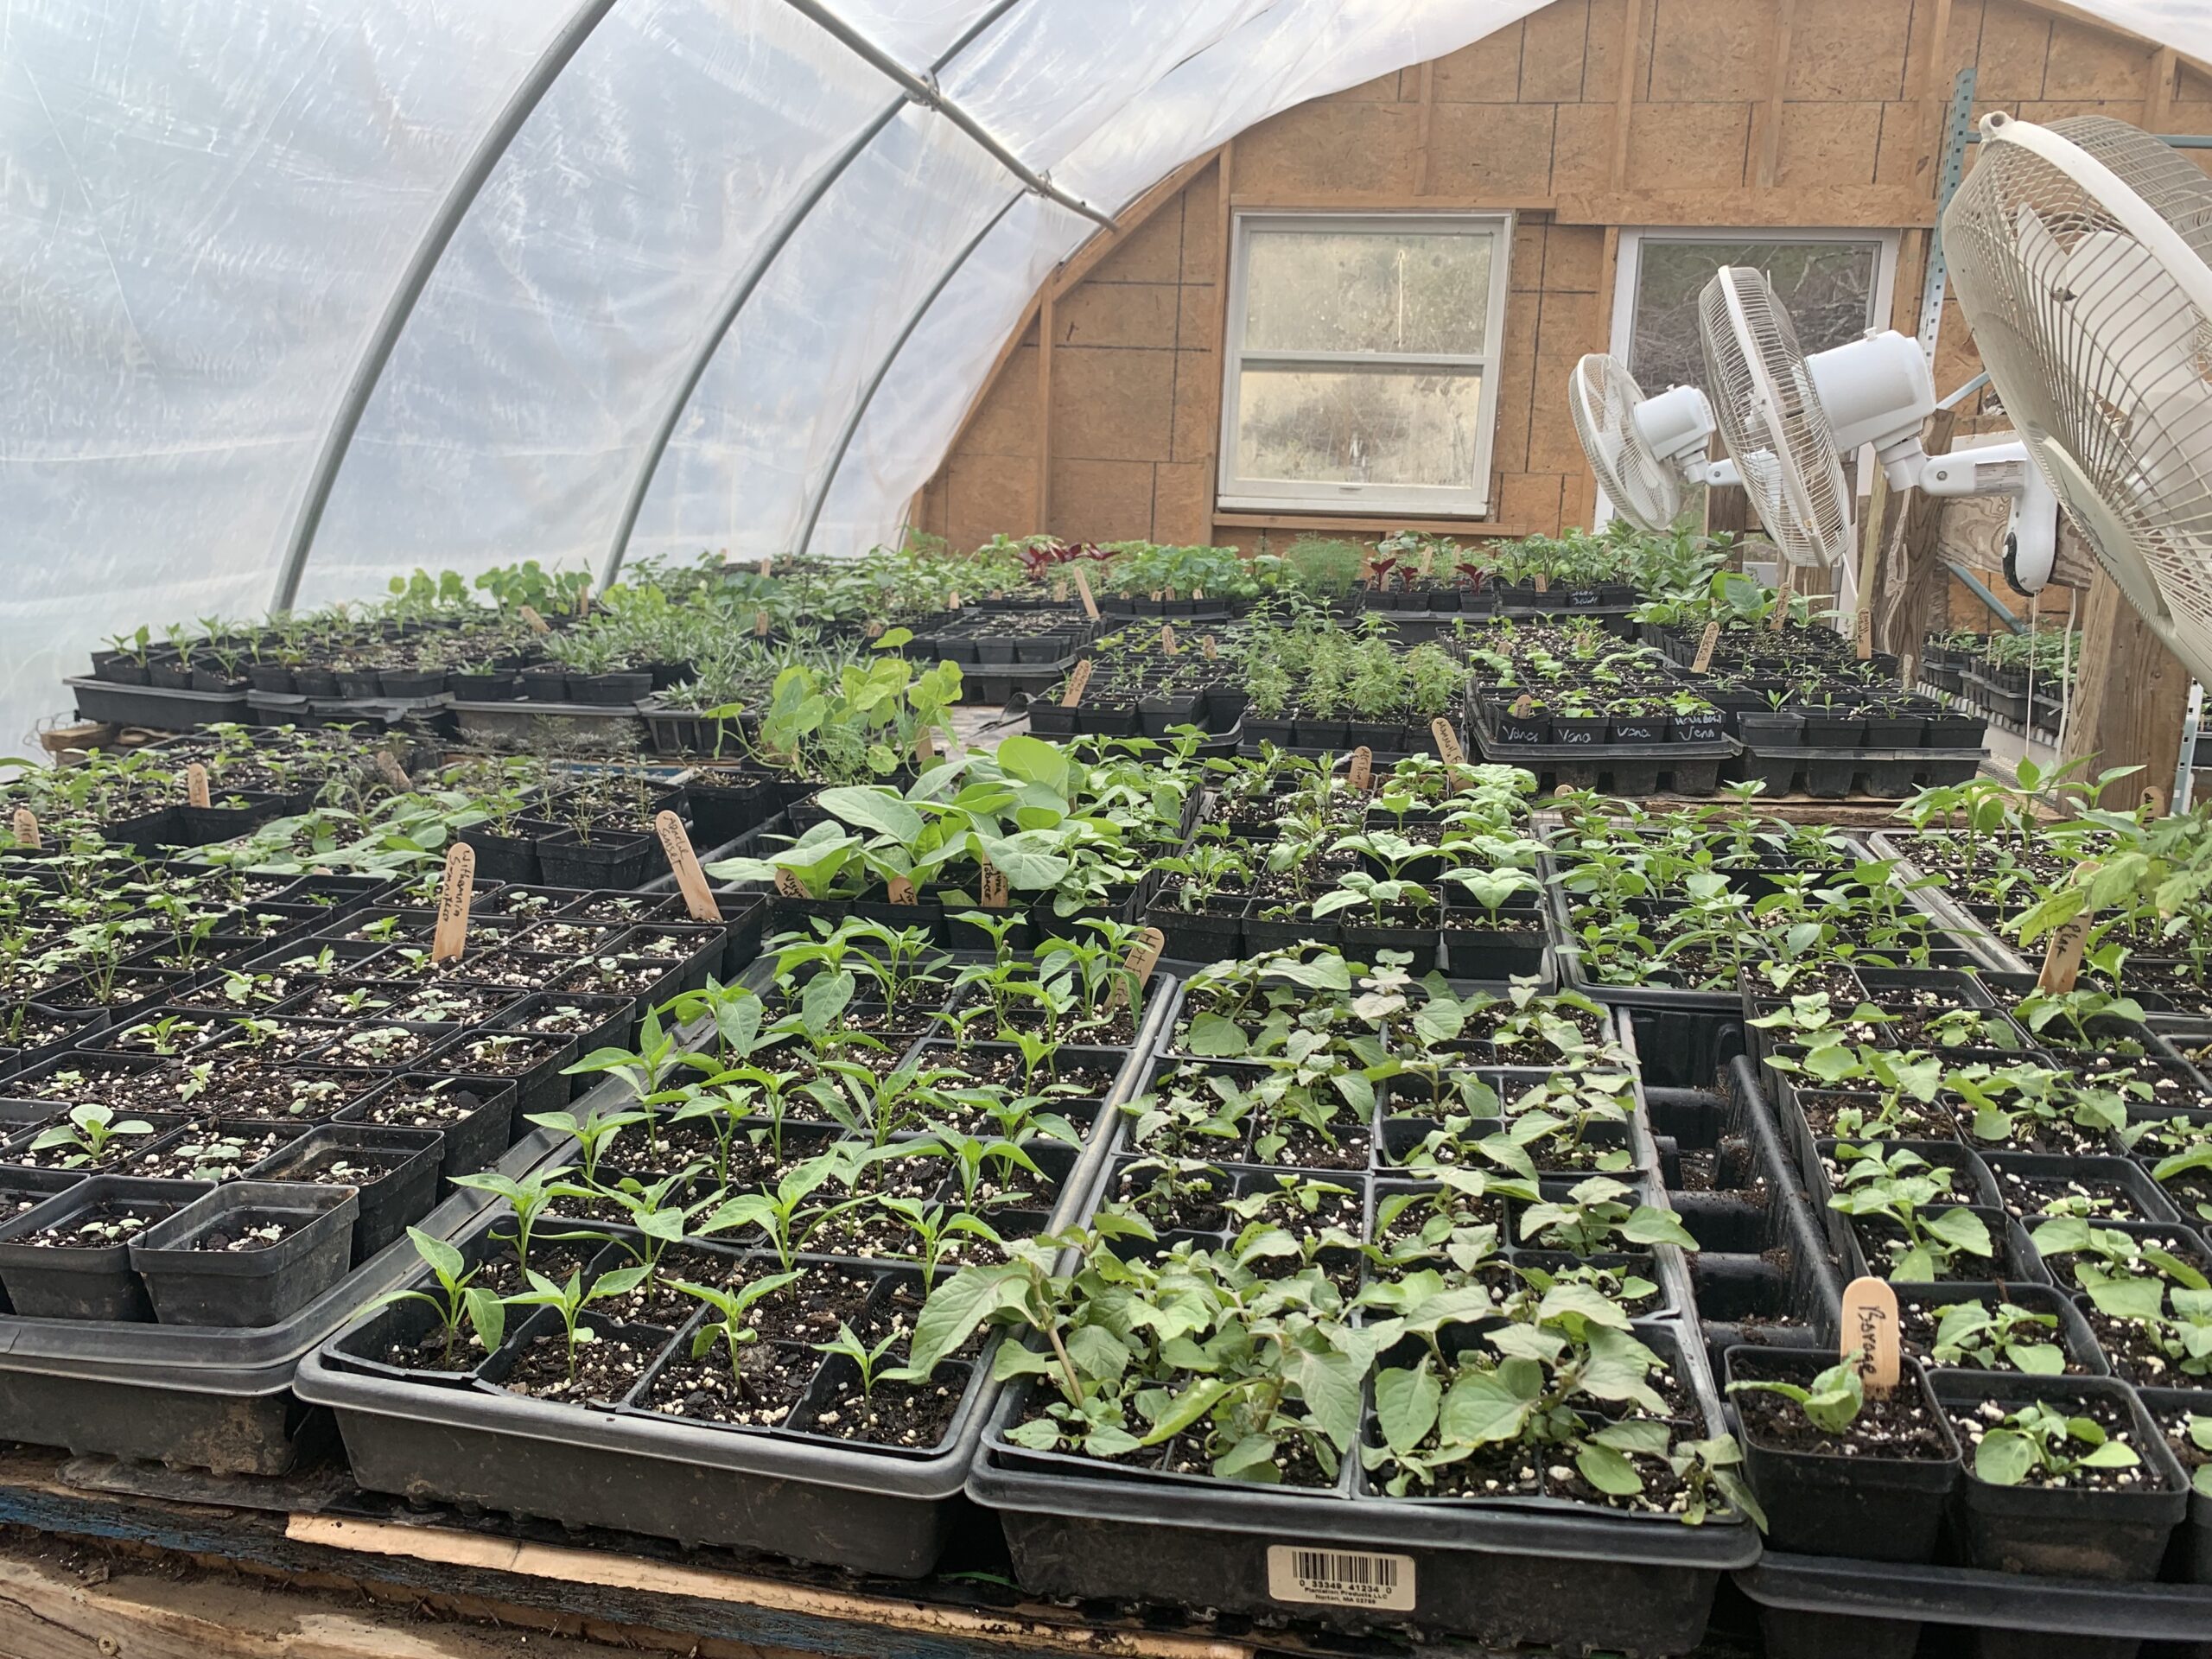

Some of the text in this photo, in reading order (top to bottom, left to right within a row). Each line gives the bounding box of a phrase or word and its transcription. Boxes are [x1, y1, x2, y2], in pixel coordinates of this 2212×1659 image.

[1852, 1306, 1886, 1380] Borage
[1348, 1583, 1380, 1593] 41234
[1340, 1590, 1372, 1599] Products
